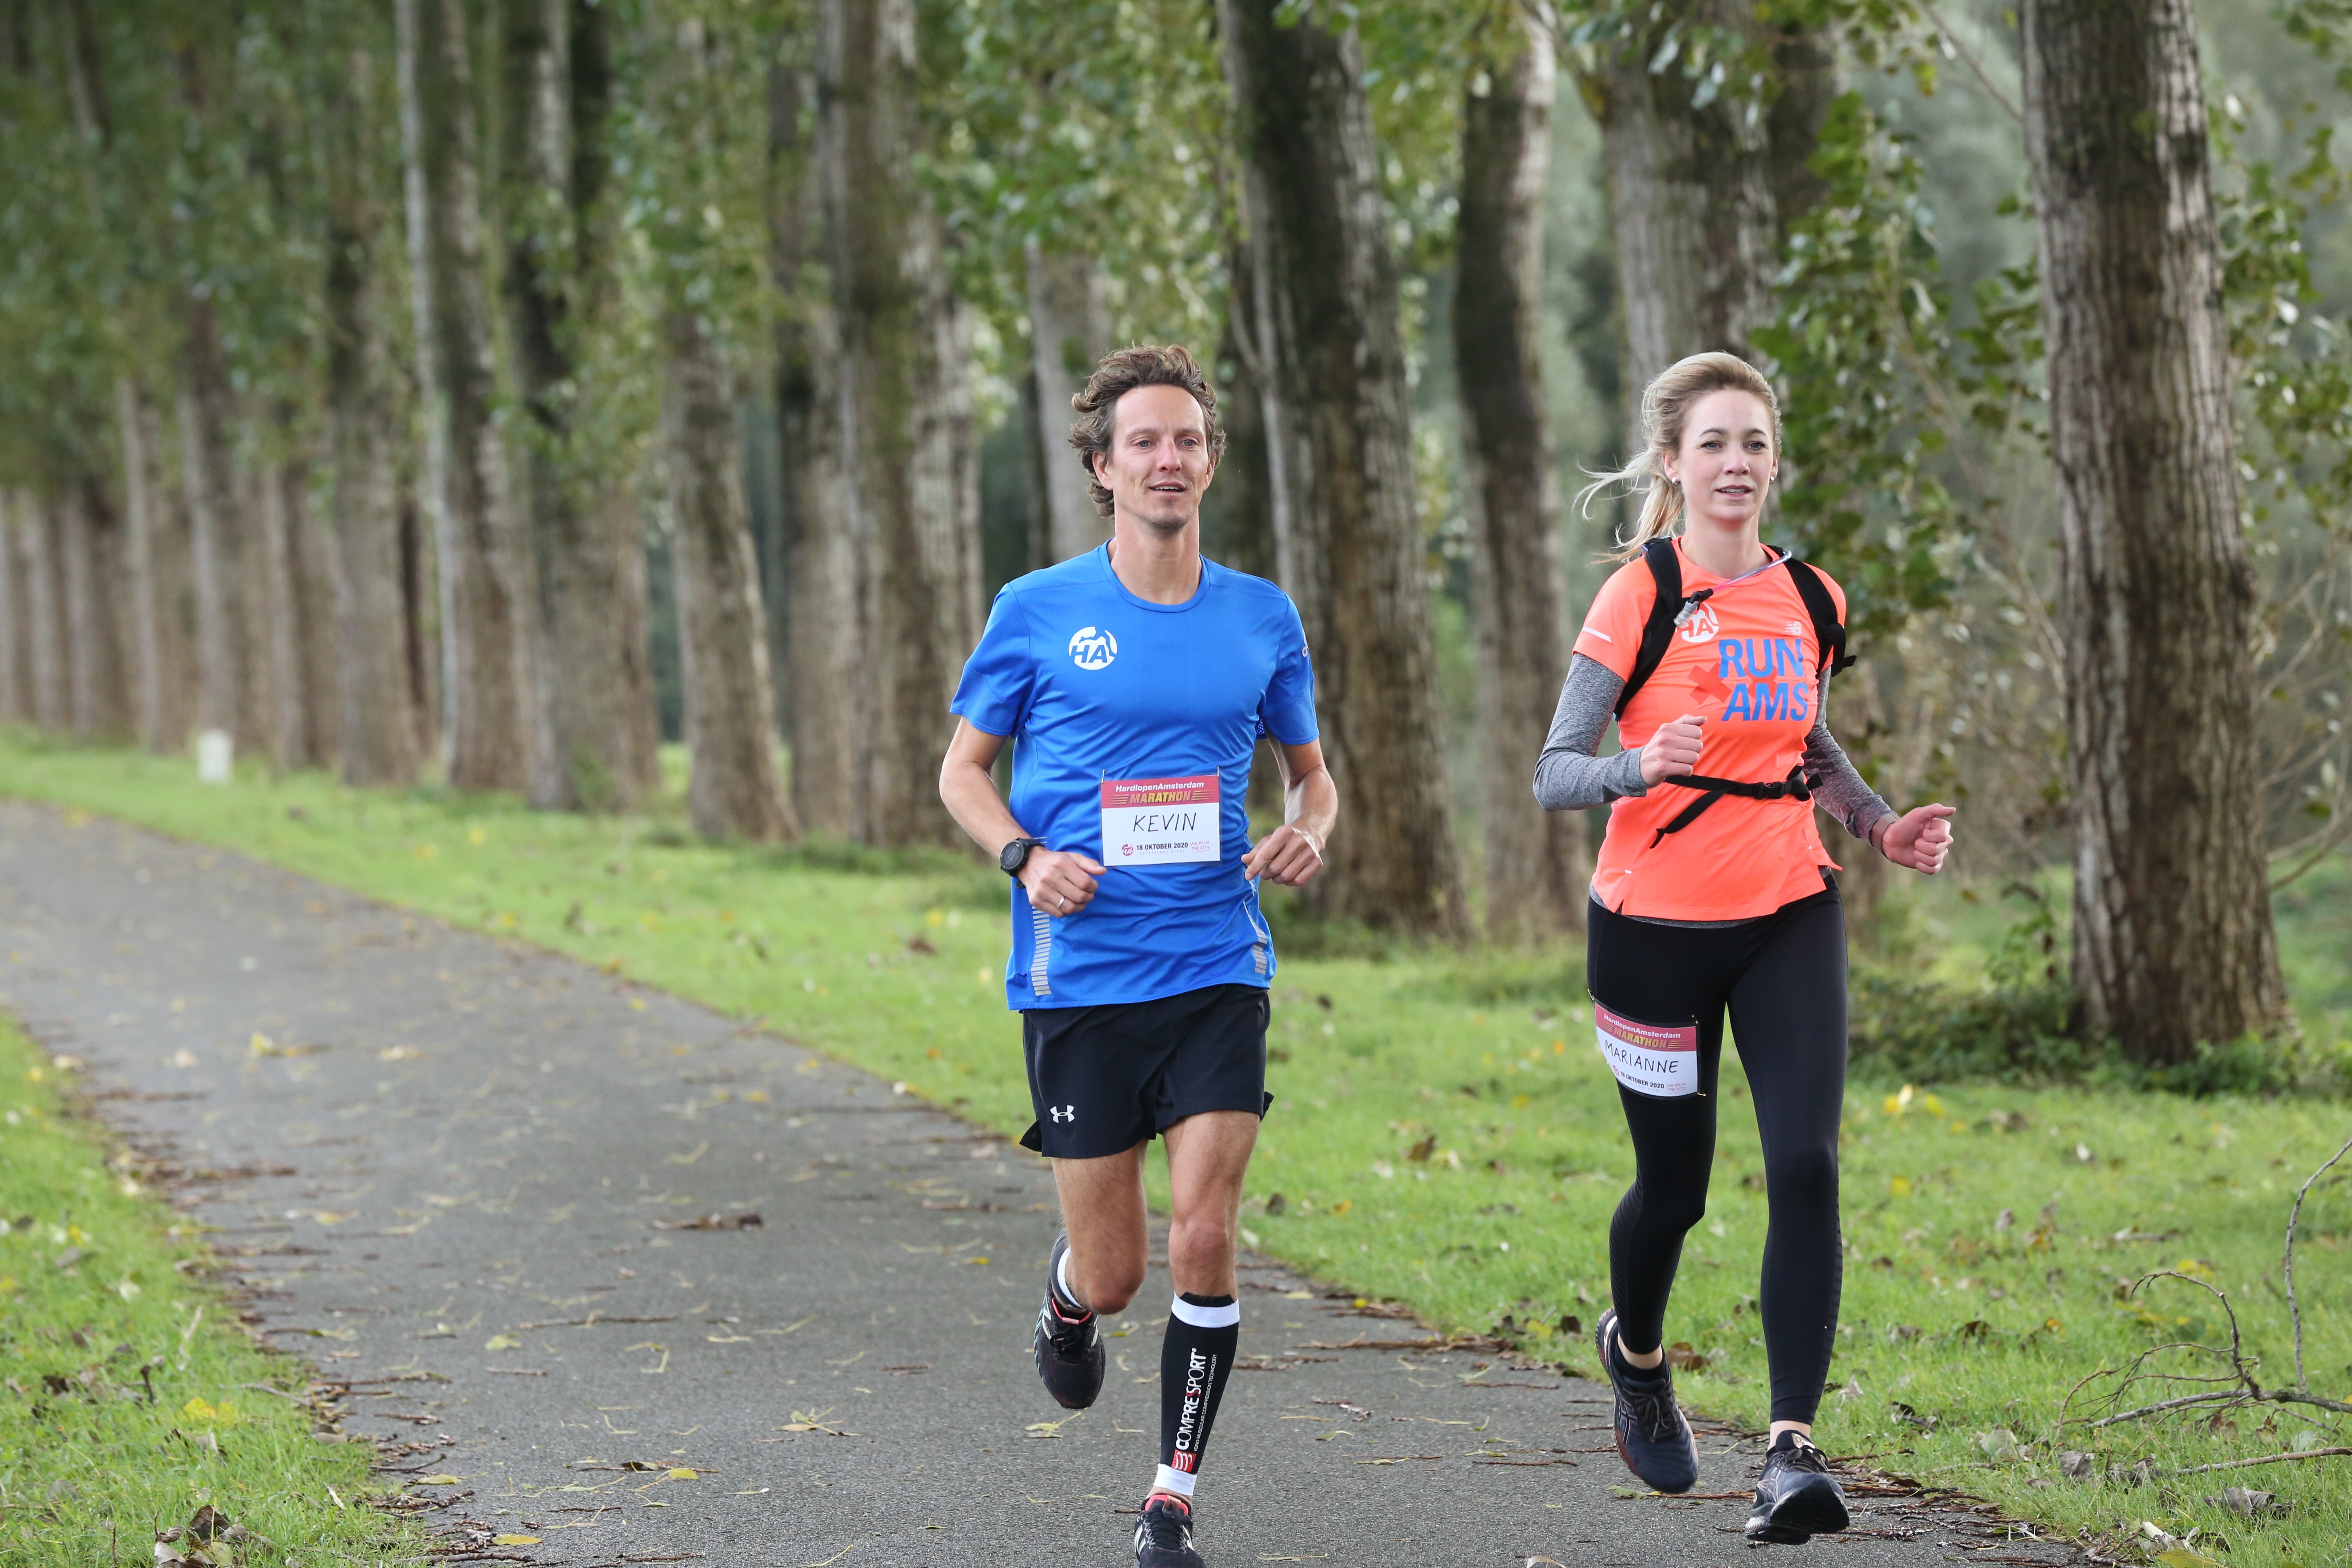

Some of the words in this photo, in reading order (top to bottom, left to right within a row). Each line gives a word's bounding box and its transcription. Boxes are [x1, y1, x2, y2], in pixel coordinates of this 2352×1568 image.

[1718, 638, 1804, 678] RUN
[1721, 682, 1809, 721] AMS
[1115, 782, 1204, 792] HardlopenAmsterdam
[1130, 791, 1191, 804] MARATHON
[1133, 813, 1196, 832] KEVIN
[1604, 1014, 1681, 1038] HardlopenAmsterdam
[1614, 1027, 1668, 1049] MARATHON
[1605, 1040, 1679, 1073] MARIANNE
[1626, 1074, 1648, 1086] OKTOBER
[1202, 1383, 1212, 1415] COMPRESSION
[1208, 1354, 1217, 1383] TECHNOLOGY
